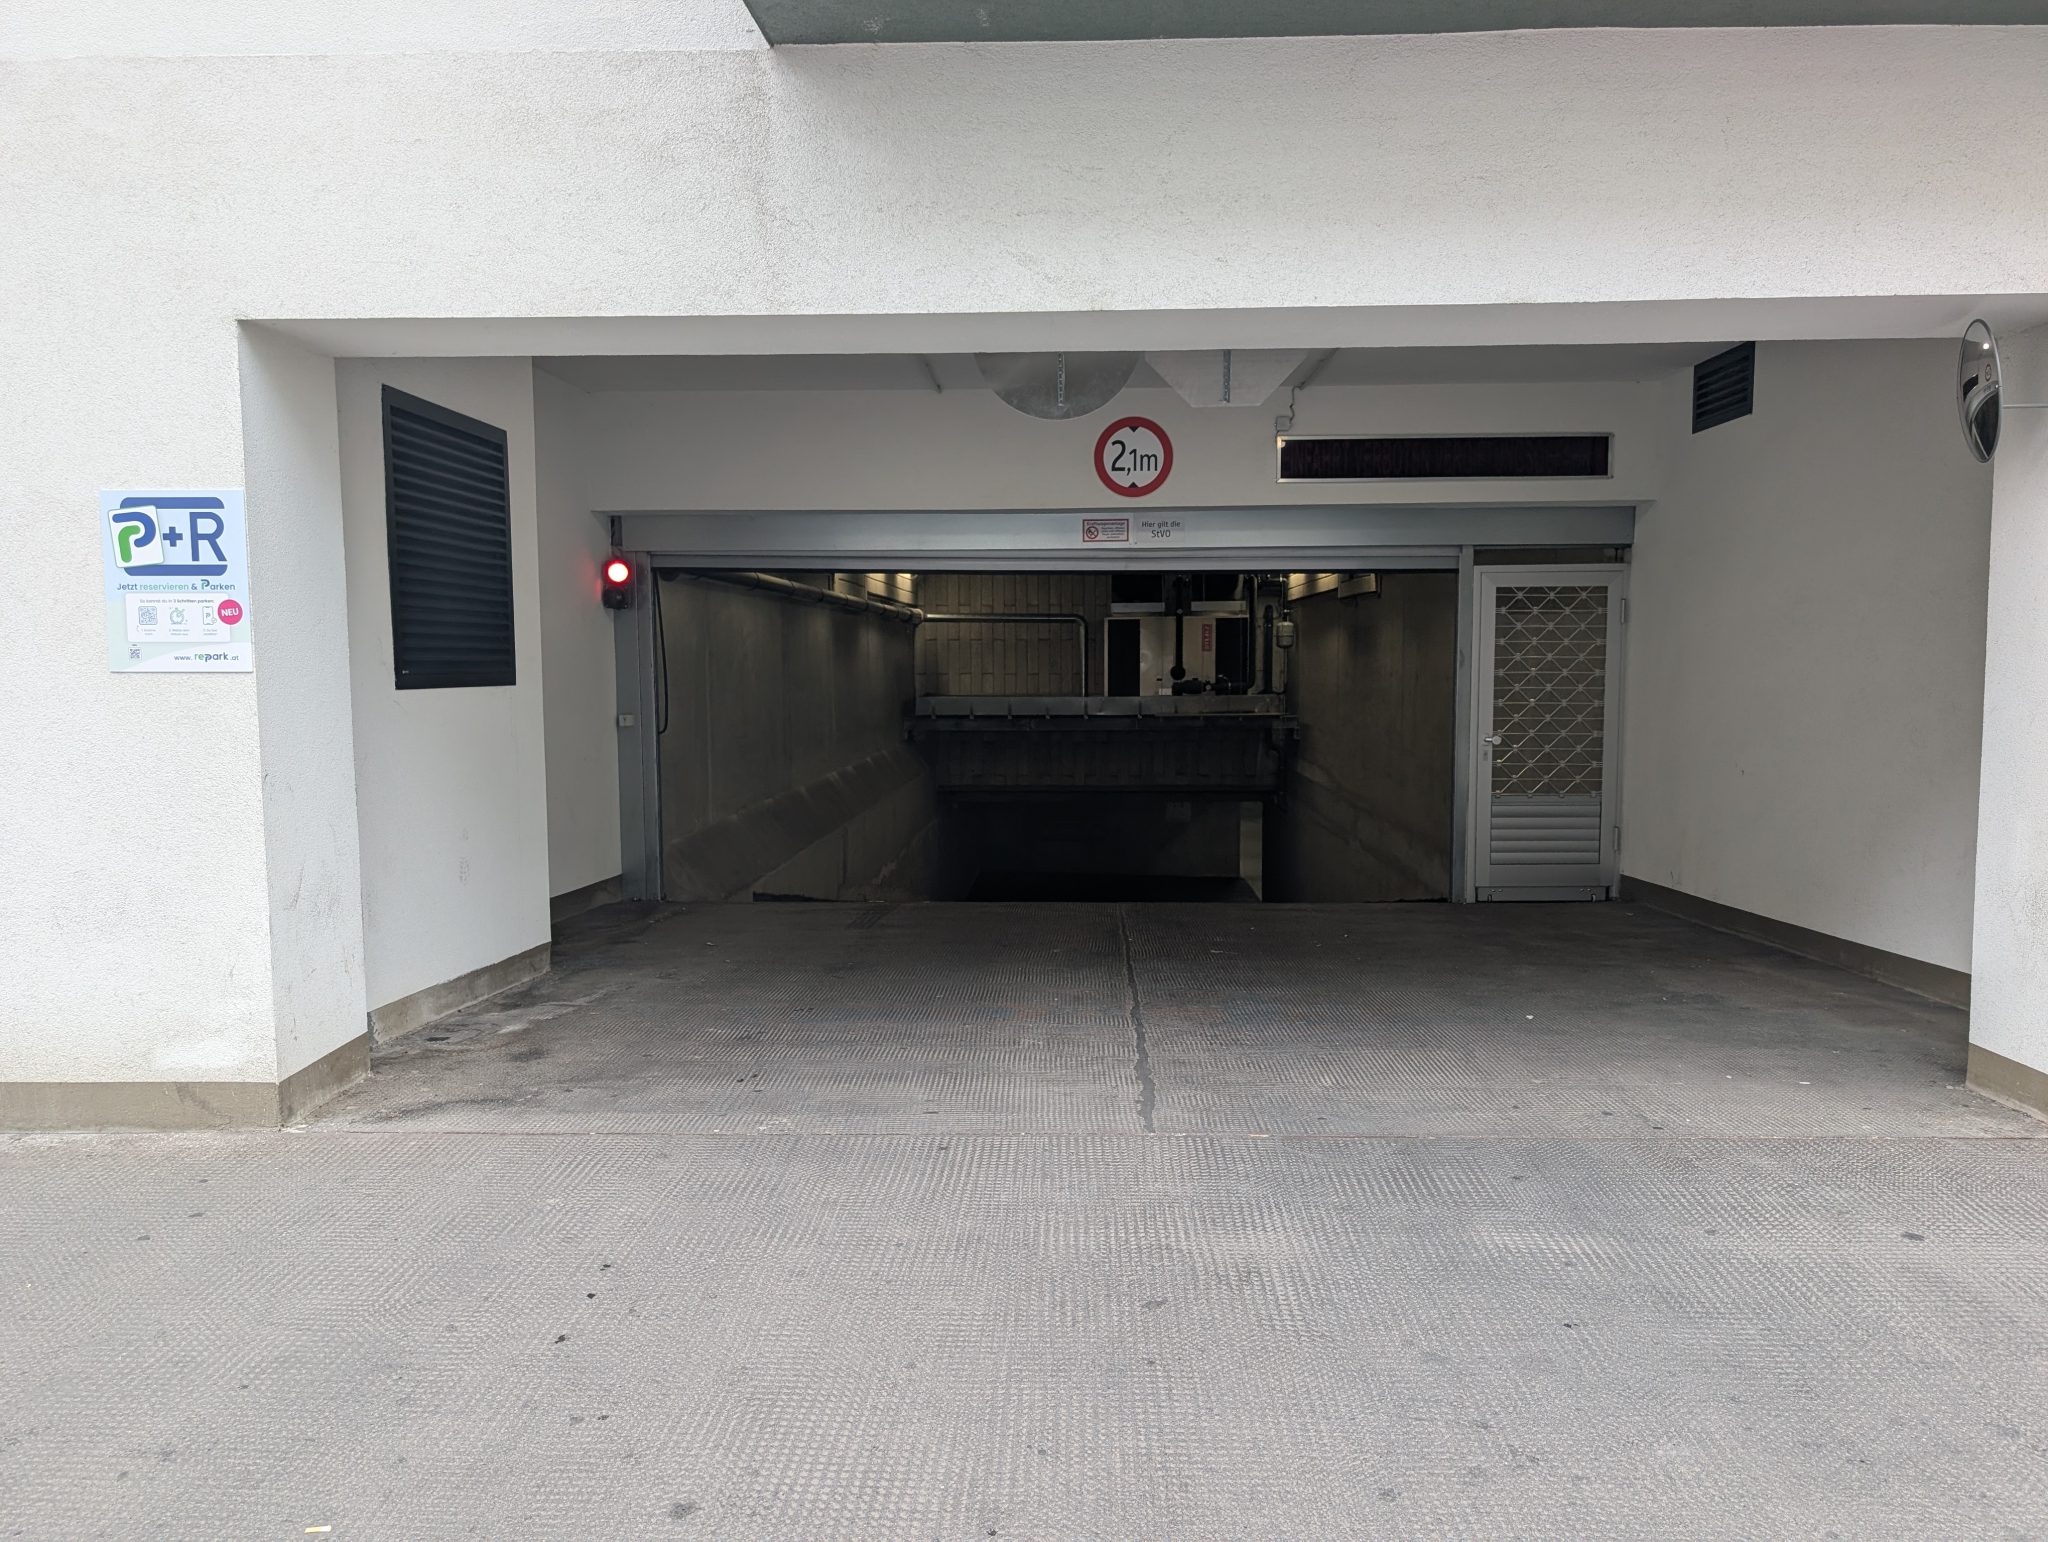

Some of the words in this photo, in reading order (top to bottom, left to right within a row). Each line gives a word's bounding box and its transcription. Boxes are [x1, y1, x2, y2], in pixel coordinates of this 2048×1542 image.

[1111, 439, 1158, 476] 2,1m
[1141, 520, 1156, 528] Hier
[1157, 520, 1169, 529] gilt
[1170, 520, 1180, 528] die
[1151, 529, 1171, 539] StVO
[117, 583, 138, 591] Jetzt
[139, 582, 189, 591] reservieren
[191, 583, 198, 591] &
[200, 579, 236, 591] Parken
[221, 607, 239, 617] NEU
